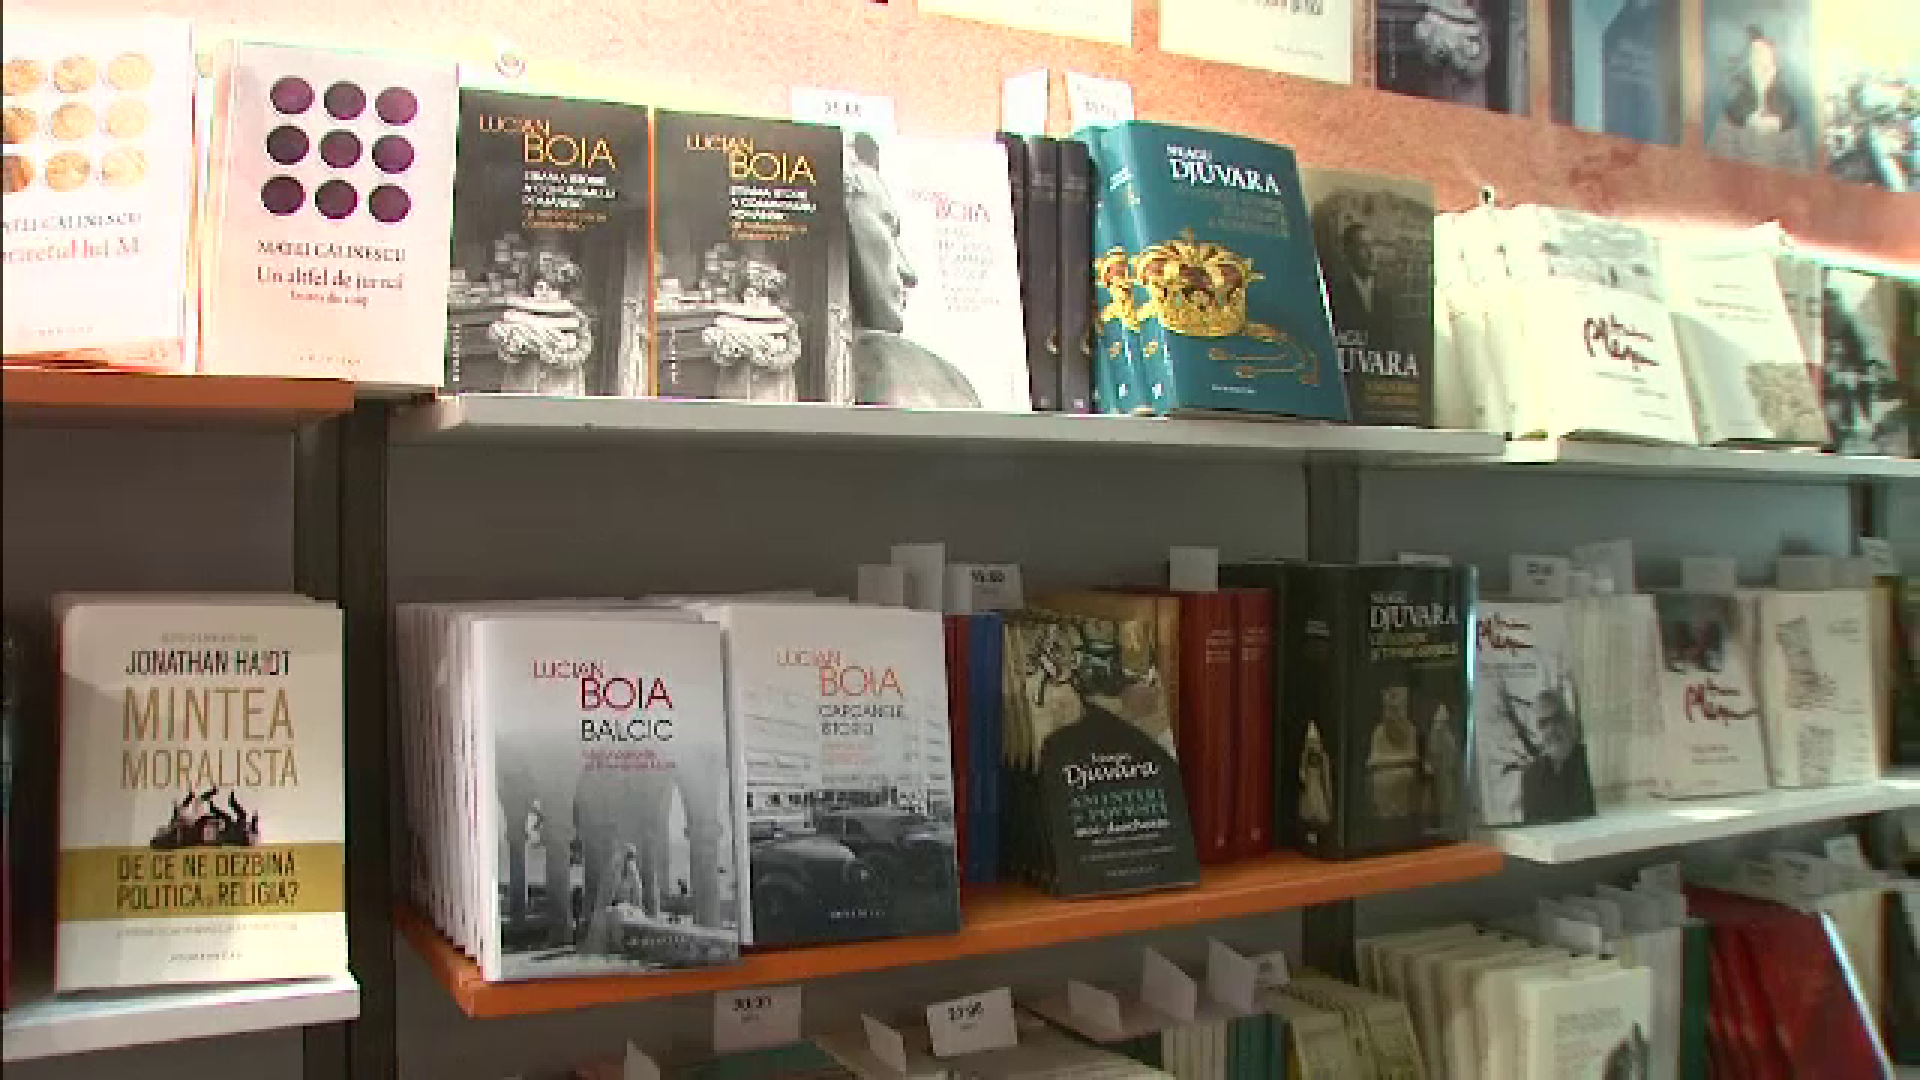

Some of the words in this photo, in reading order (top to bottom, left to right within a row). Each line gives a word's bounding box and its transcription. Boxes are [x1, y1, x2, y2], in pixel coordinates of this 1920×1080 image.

[479, 113, 550, 136] LUCIAN
[523, 134, 618, 170] BOIA
[686, 133, 755, 154] LUCIAN
[730, 151, 818, 185] BOIA
[1168, 158, 1282, 196] DJUVARA
[257, 266, 283, 283] Un
[332, 269, 352, 288] de
[1336, 347, 1420, 378] UVARA
[1370, 602, 1459, 630] DJUVARA
[125, 650, 230, 676] JONATHAN
[532, 660, 607, 680] LUCIAN
[776, 649, 841, 669] LUCIAN
[580, 676, 674, 711] BOIA
[819, 666, 905, 698] BOIA
[122, 687, 295, 742] MINTEA
[580, 719, 674, 742] BALCIC
[1062, 759, 1160, 790] Djuvara
[117, 853, 145, 881] DE
[151, 851, 176, 880] CE
[183, 850, 208, 878] NE
[116, 884, 203, 910] POLITICA
